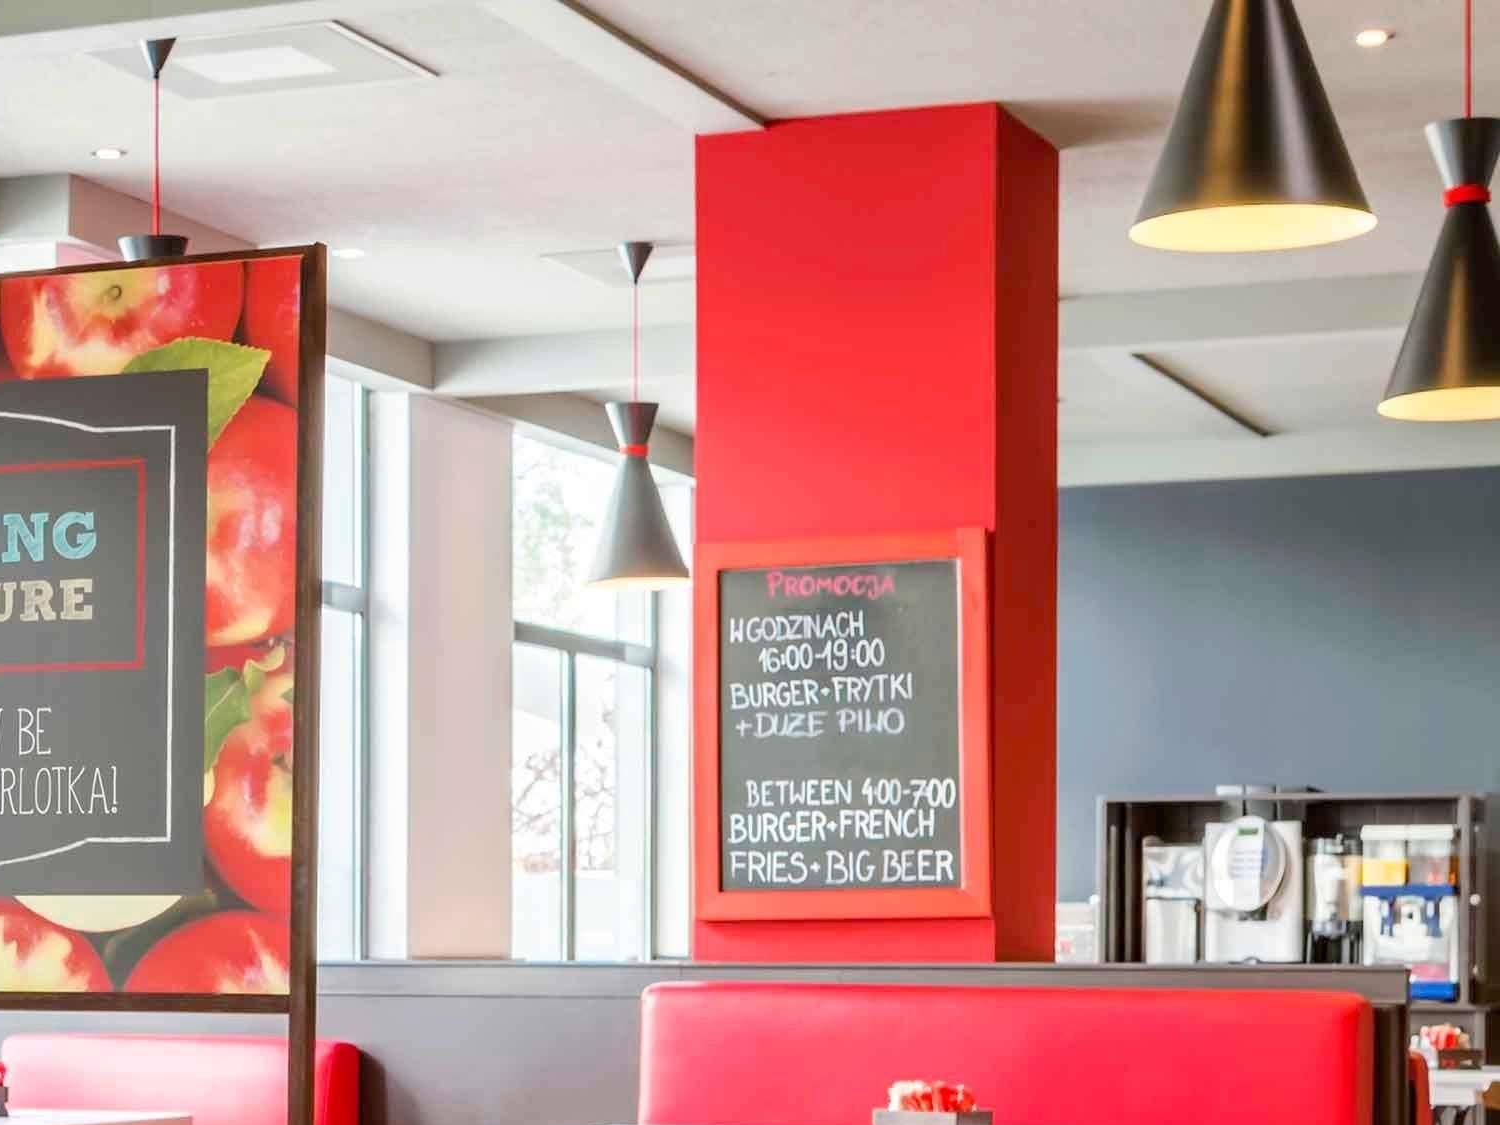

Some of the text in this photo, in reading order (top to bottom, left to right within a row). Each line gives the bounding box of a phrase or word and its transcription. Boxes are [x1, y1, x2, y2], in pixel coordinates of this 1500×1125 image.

[17, 707, 53, 757] BE
[836, 707, 905, 735] PIWO
[745, 779, 852, 808] BETWEEN
[825, 850, 875, 885] BIG
[881, 849, 954, 883] BEER
